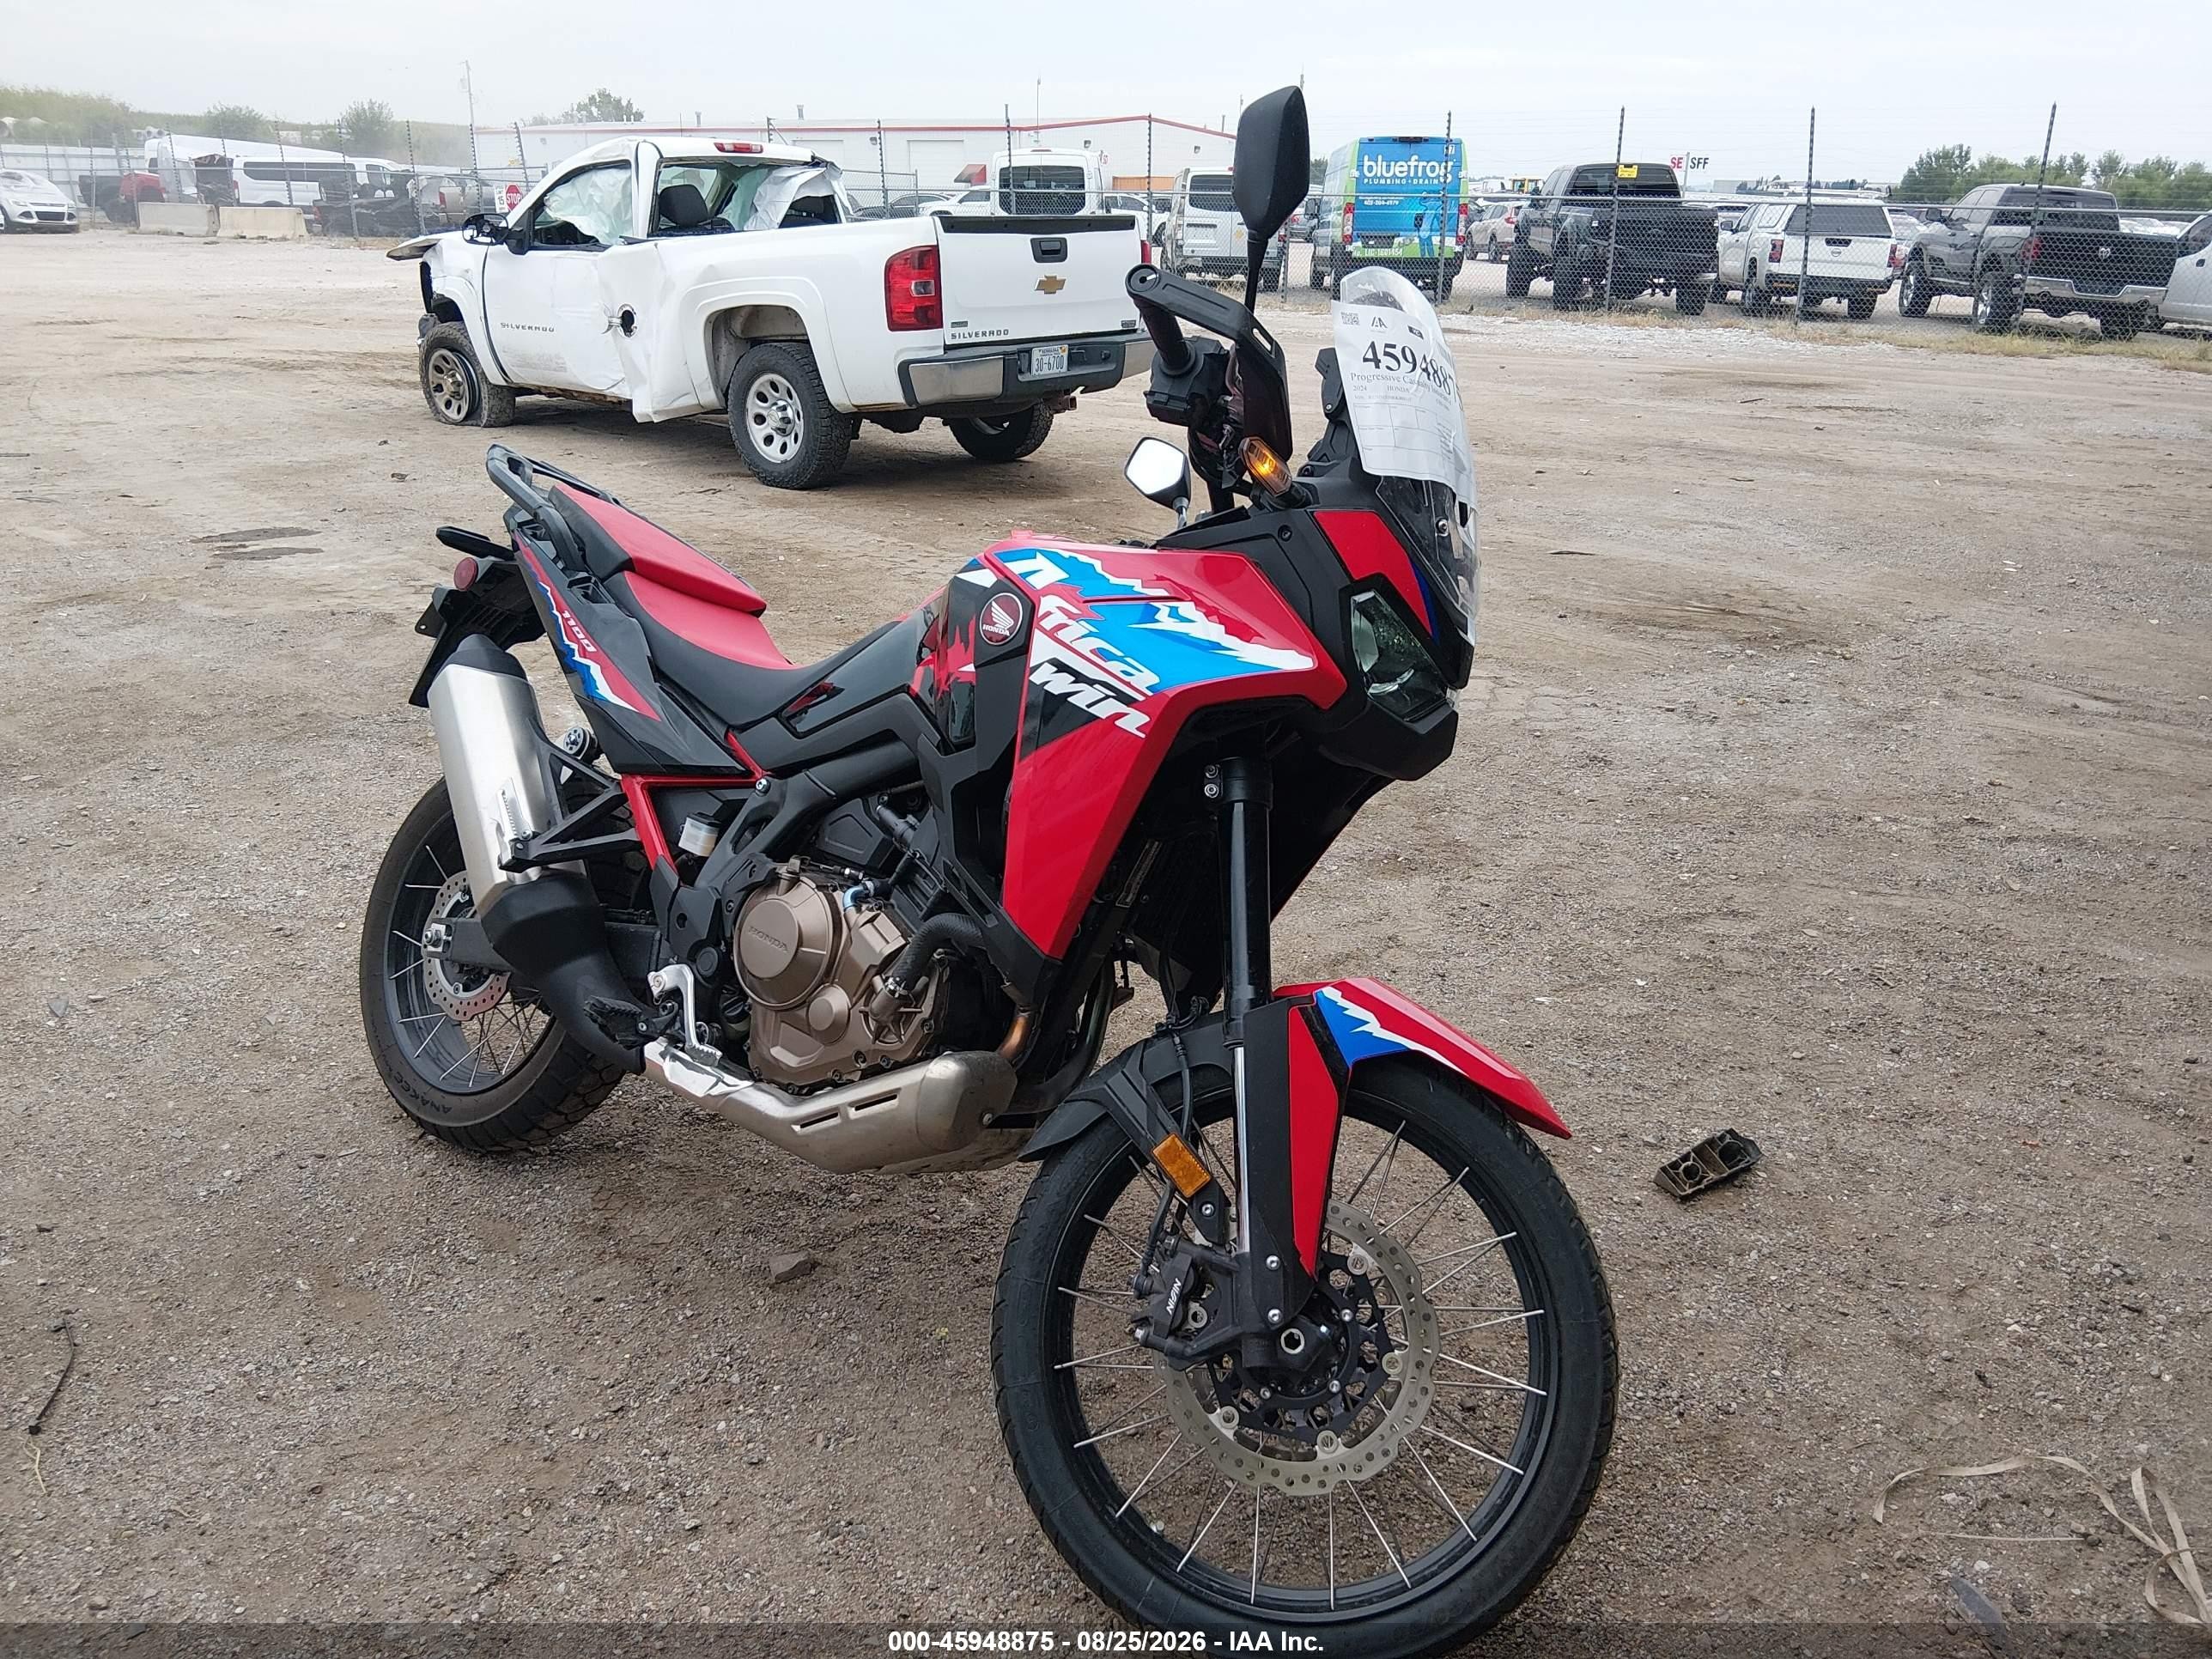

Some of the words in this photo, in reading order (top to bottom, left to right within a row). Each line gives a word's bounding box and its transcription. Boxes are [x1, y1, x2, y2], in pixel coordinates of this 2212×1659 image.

[1363, 155, 1454, 183] bluefrog
[1670, 156, 1684, 169] SE
[1689, 156, 1710, 169] SFF
[507, 193, 522, 204] STOP
[951, 329, 1009, 340] SILVERADO
[1351, 372, 1401, 383] Progressive
[982, 623, 1010, 636] HONDA
[748, 926, 788, 953] HONDA
[394, 1071, 453, 1115] ANAKEE
